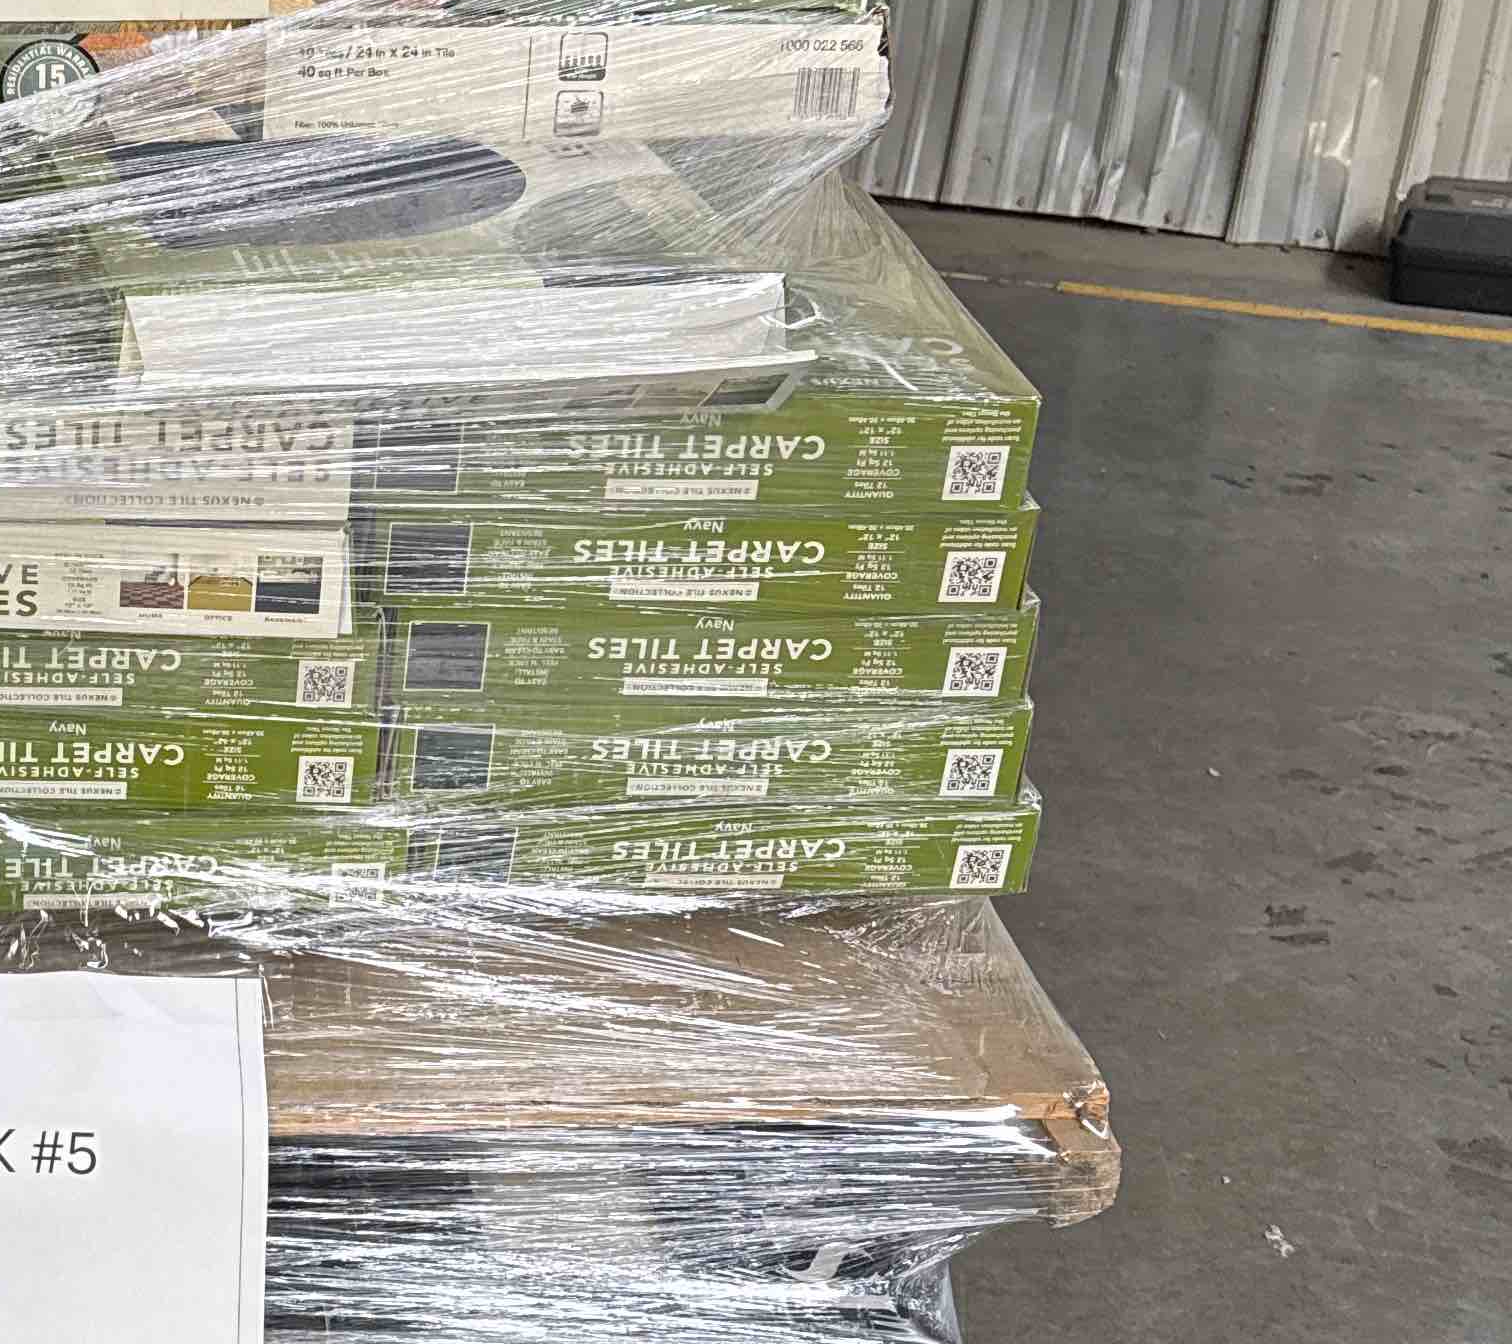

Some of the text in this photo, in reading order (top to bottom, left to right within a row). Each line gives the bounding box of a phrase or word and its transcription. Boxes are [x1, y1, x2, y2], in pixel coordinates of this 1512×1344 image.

[813, 39, 837, 52] 022
[35, 63, 66, 89] 15
[679, 409, 722, 427] Navy
[567, 433, 826, 459] CARPET TILES
[603, 460, 774, 476] SELF-ADHESIVE
[683, 518, 725, 535] Navy
[571, 539, 826, 563] CARPET TILES
[609, 565, 775, 579] SELF-ADHESIVE
[695, 616, 736, 633] Navy
[587, 636, 833, 660] CARPET TILES
[44, 647, 182, 672] CARPET
[622, 661, 784, 676] SELF-ADHESIVE
[47, 720, 88, 737] Navy
[51, 742, 185, 766] CARPET
[590, 737, 833, 761] CARPET TILES
[714, 819, 754, 836] Navy
[611, 838, 847, 861] CARPET TILES
[31, 1130, 97, 1176] #5
